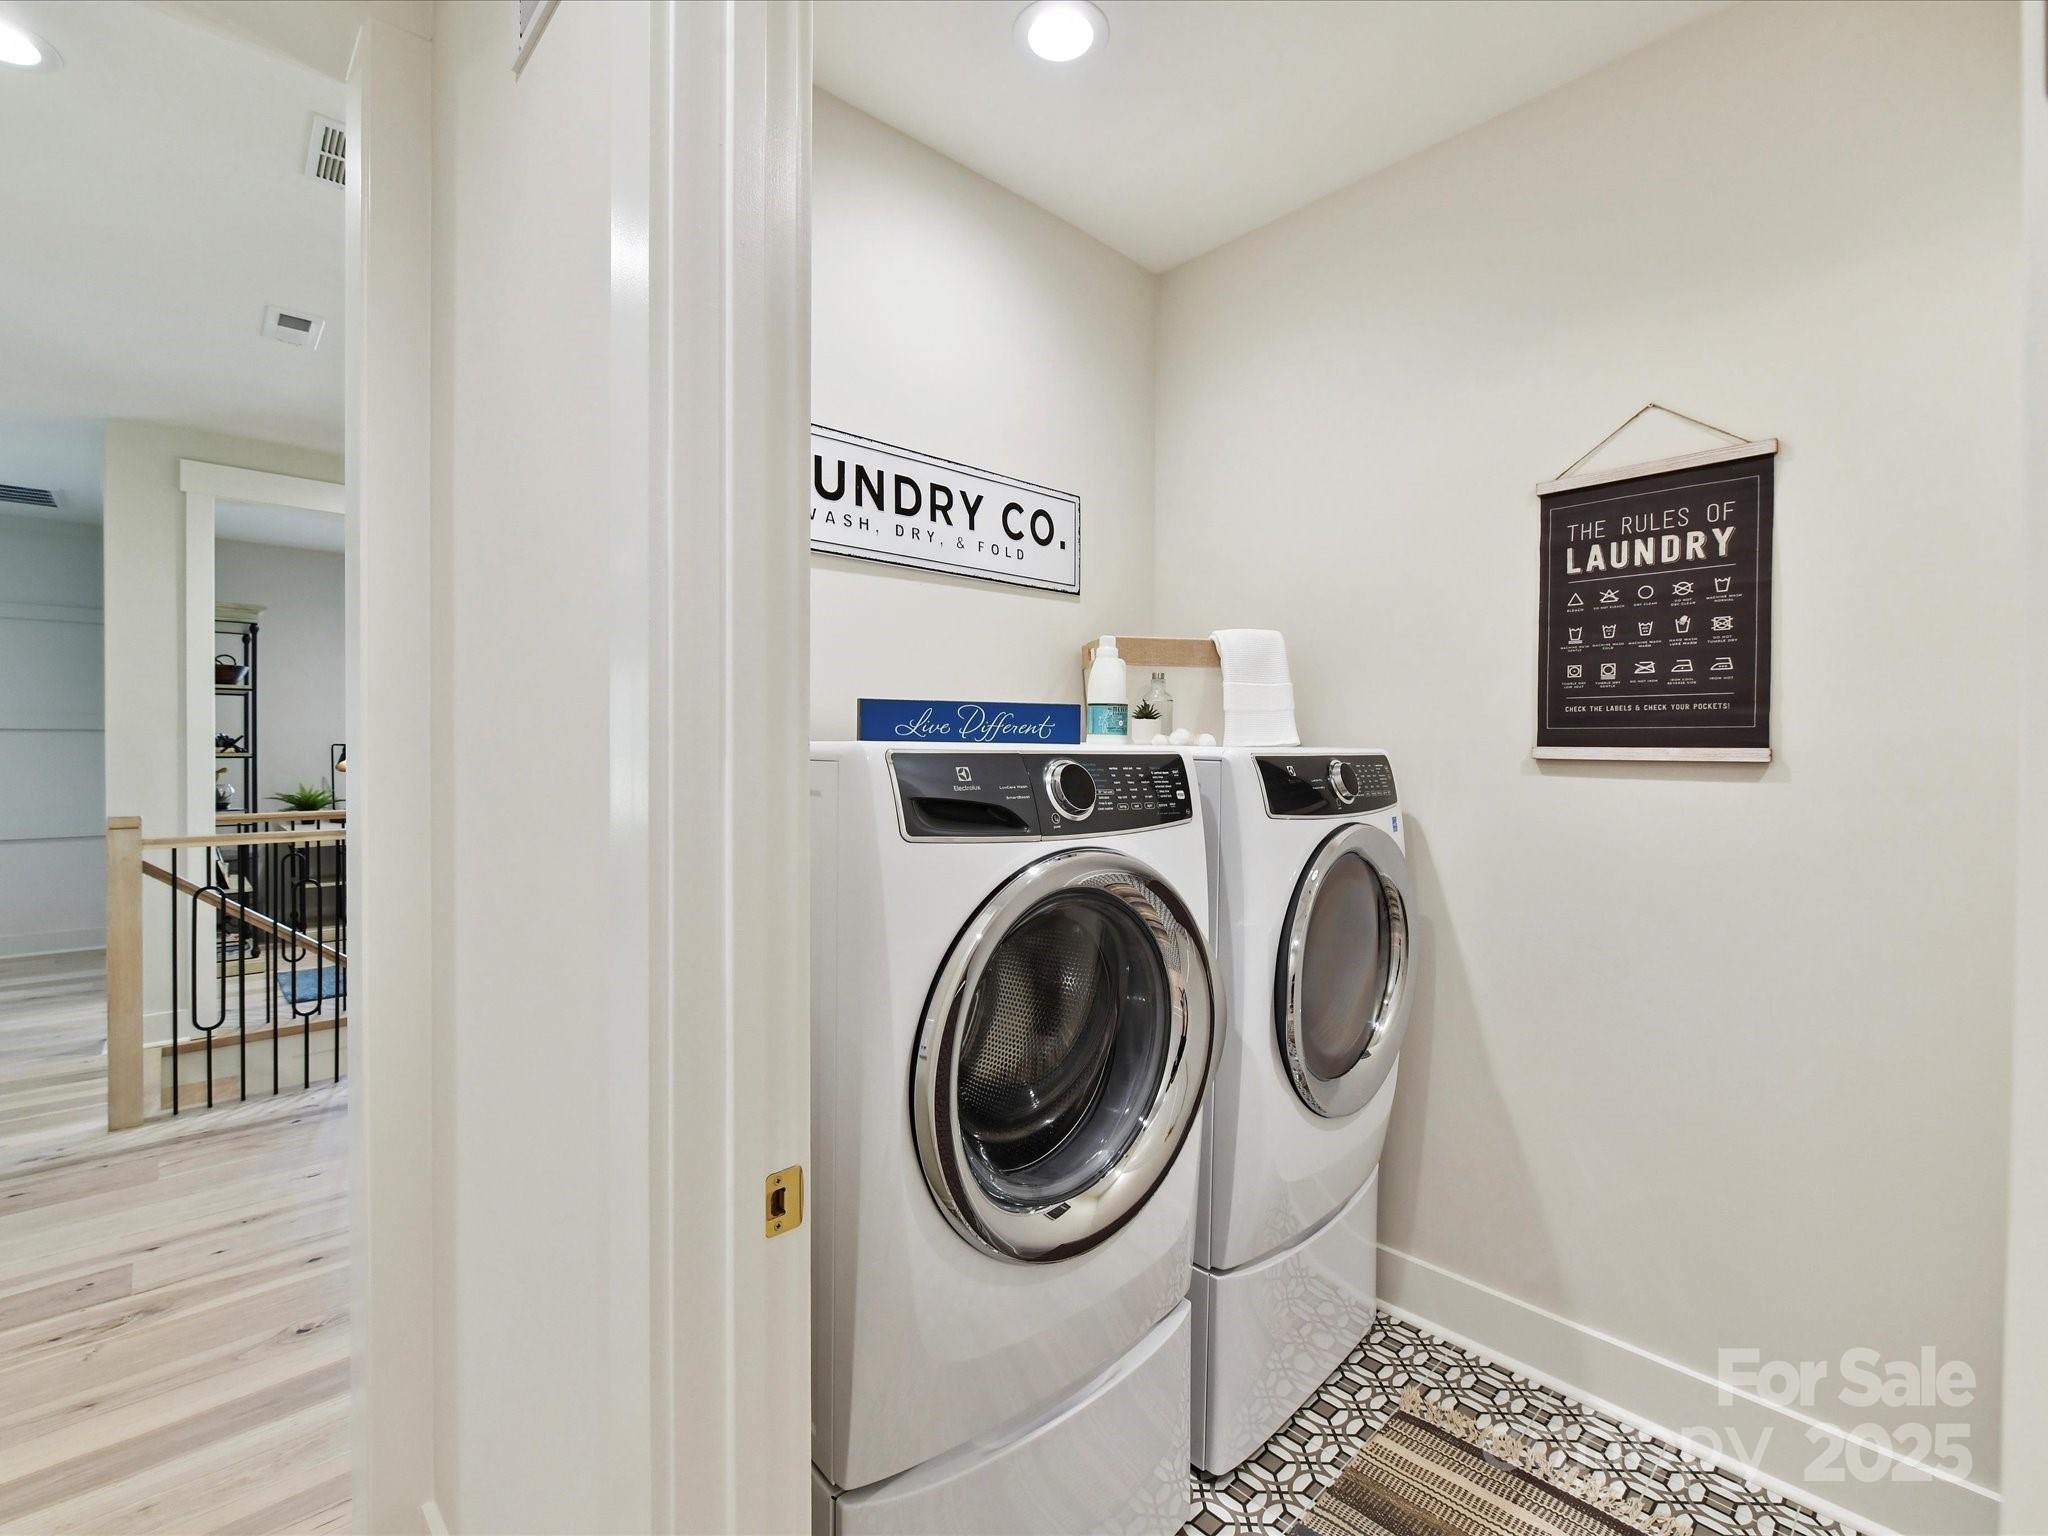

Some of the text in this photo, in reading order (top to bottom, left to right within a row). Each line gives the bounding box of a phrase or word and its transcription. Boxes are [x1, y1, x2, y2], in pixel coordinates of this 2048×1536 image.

[1002, 501, 1066, 550] CO.
[1567, 501, 1736, 542] THE RULES OF
[895, 524, 944, 548] DRY,
[956, 536, 965, 549] &
[978, 541, 1025, 560] FOLD
[1566, 526, 1737, 575] LAUNDRY
[895, 704, 1056, 742] Live Different
[1565, 705, 1586, 713] CHECK
[1606, 704, 1633, 712] LABELS
[1644, 703, 1667, 711] CHECK
[1671, 703, 1690, 711] YOUR
[1693, 702, 1731, 711] POCKETS!
